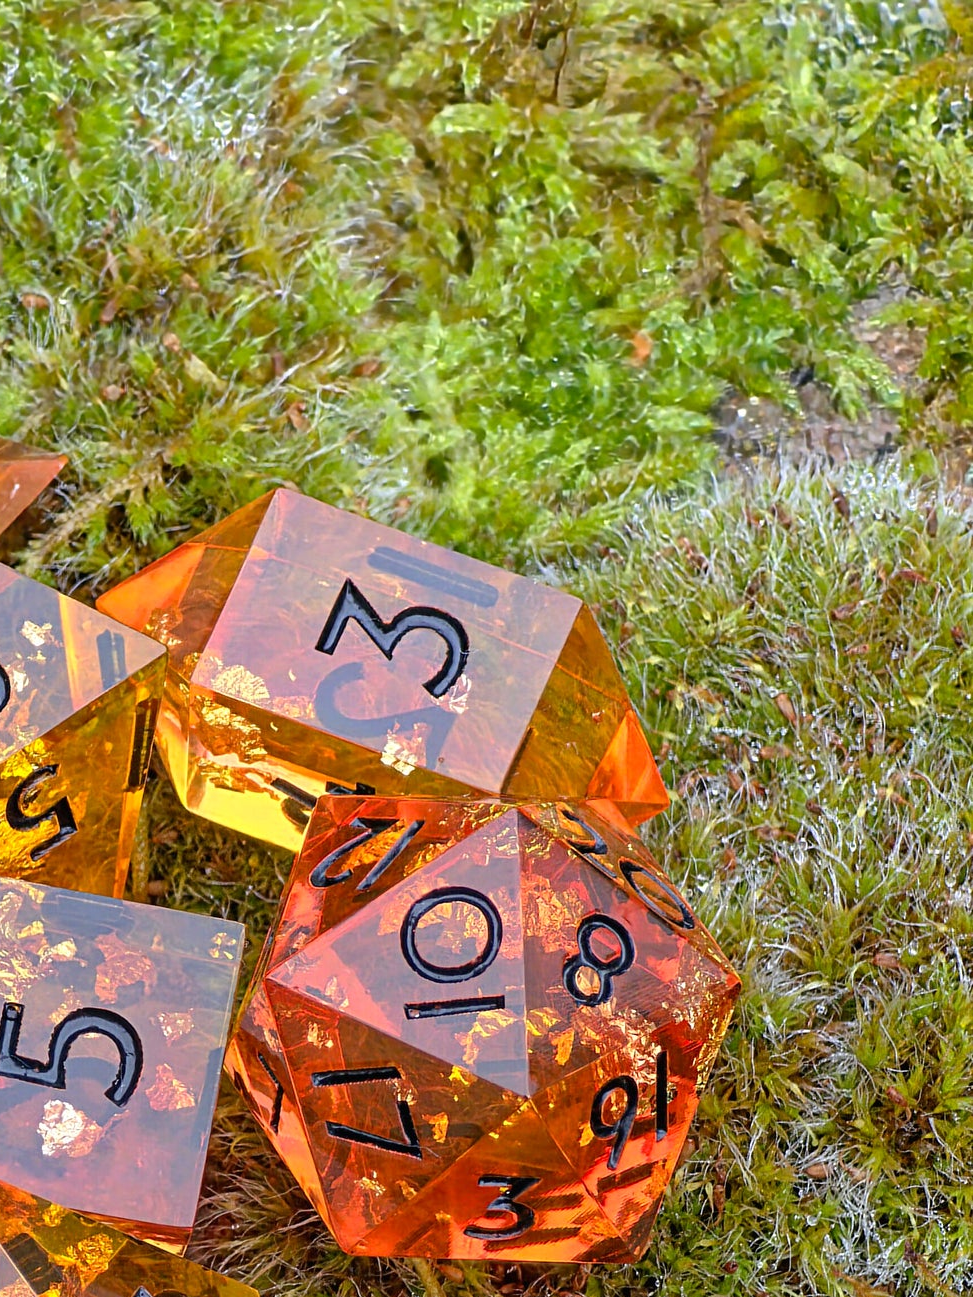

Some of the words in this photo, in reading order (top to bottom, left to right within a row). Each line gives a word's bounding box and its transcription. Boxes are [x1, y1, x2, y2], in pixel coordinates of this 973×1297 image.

[314, 577, 470, 699] 3
[5, 763, 78, 862] 5
[400, 886, 506, 1020] 10
[562, 914, 637, 1007] 8
[311, 1066, 423, 1160] 17
[463, 1174, 542, 1241] 3
